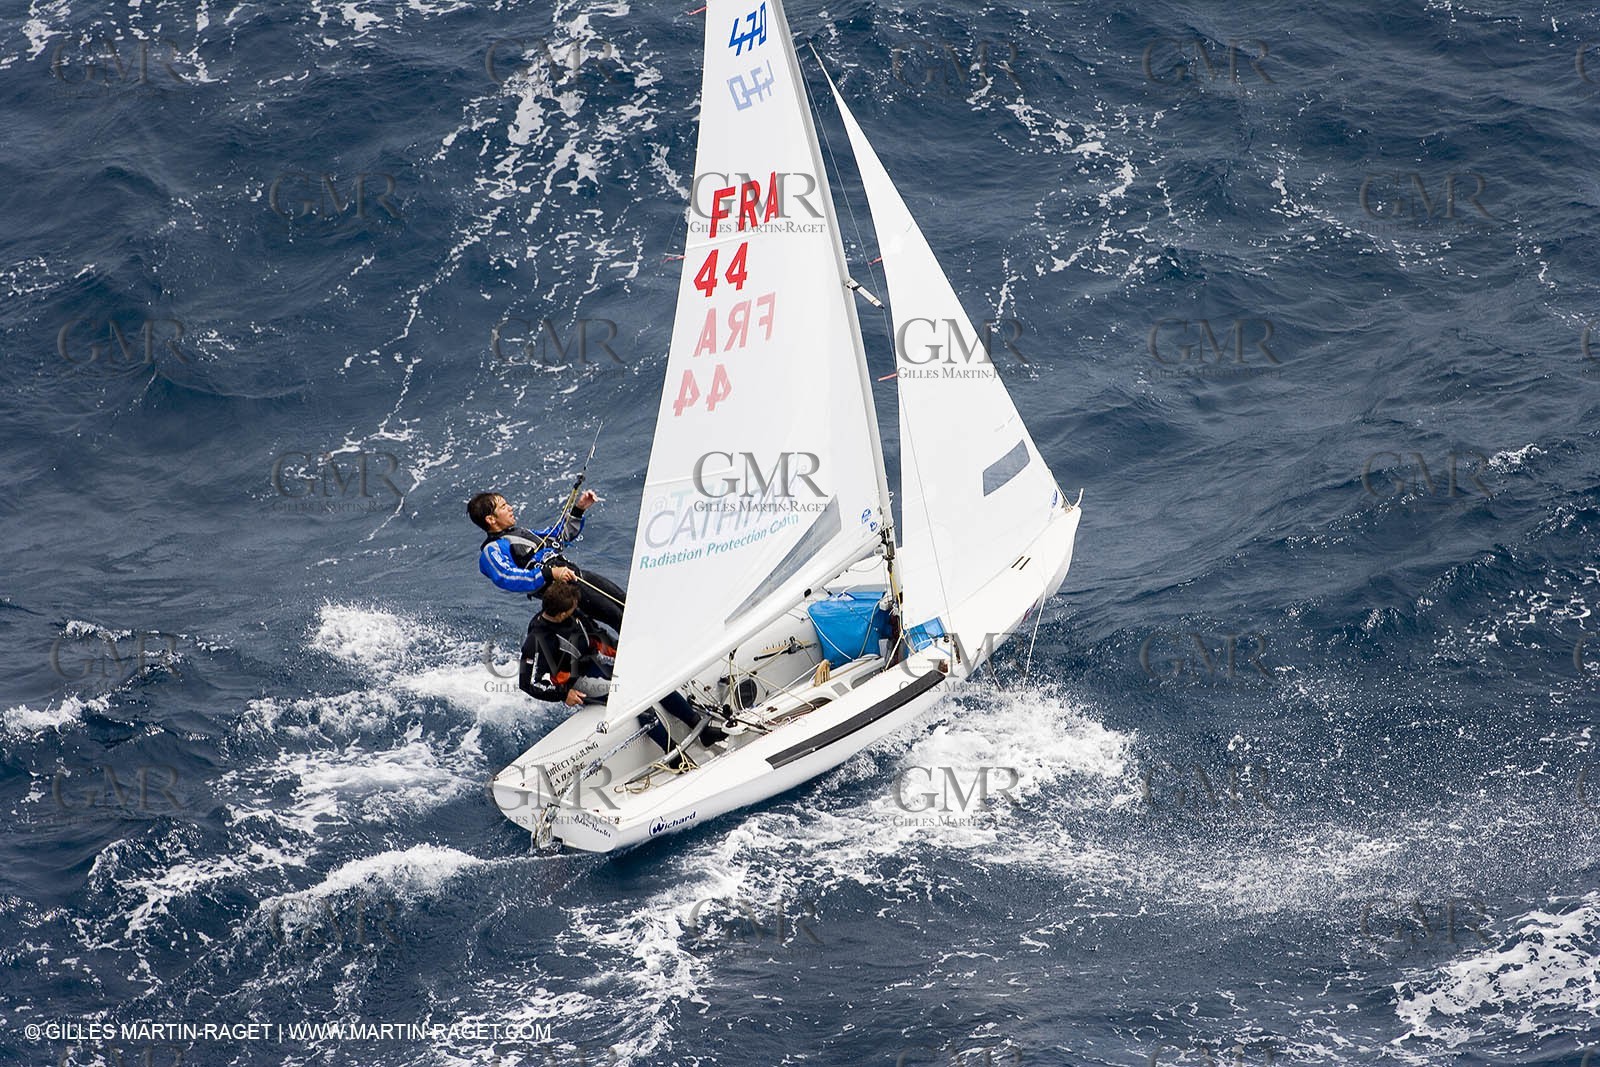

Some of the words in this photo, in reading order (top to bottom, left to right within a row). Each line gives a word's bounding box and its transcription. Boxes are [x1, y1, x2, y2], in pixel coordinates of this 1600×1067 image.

[728, 1, 767, 57] 470
[709, 171, 779, 238] FRA
[693, 242, 748, 297] 44
[639, 548, 702, 570] Radiation
[706, 529, 767, 556] Protection
[651, 811, 697, 835] Wichard
